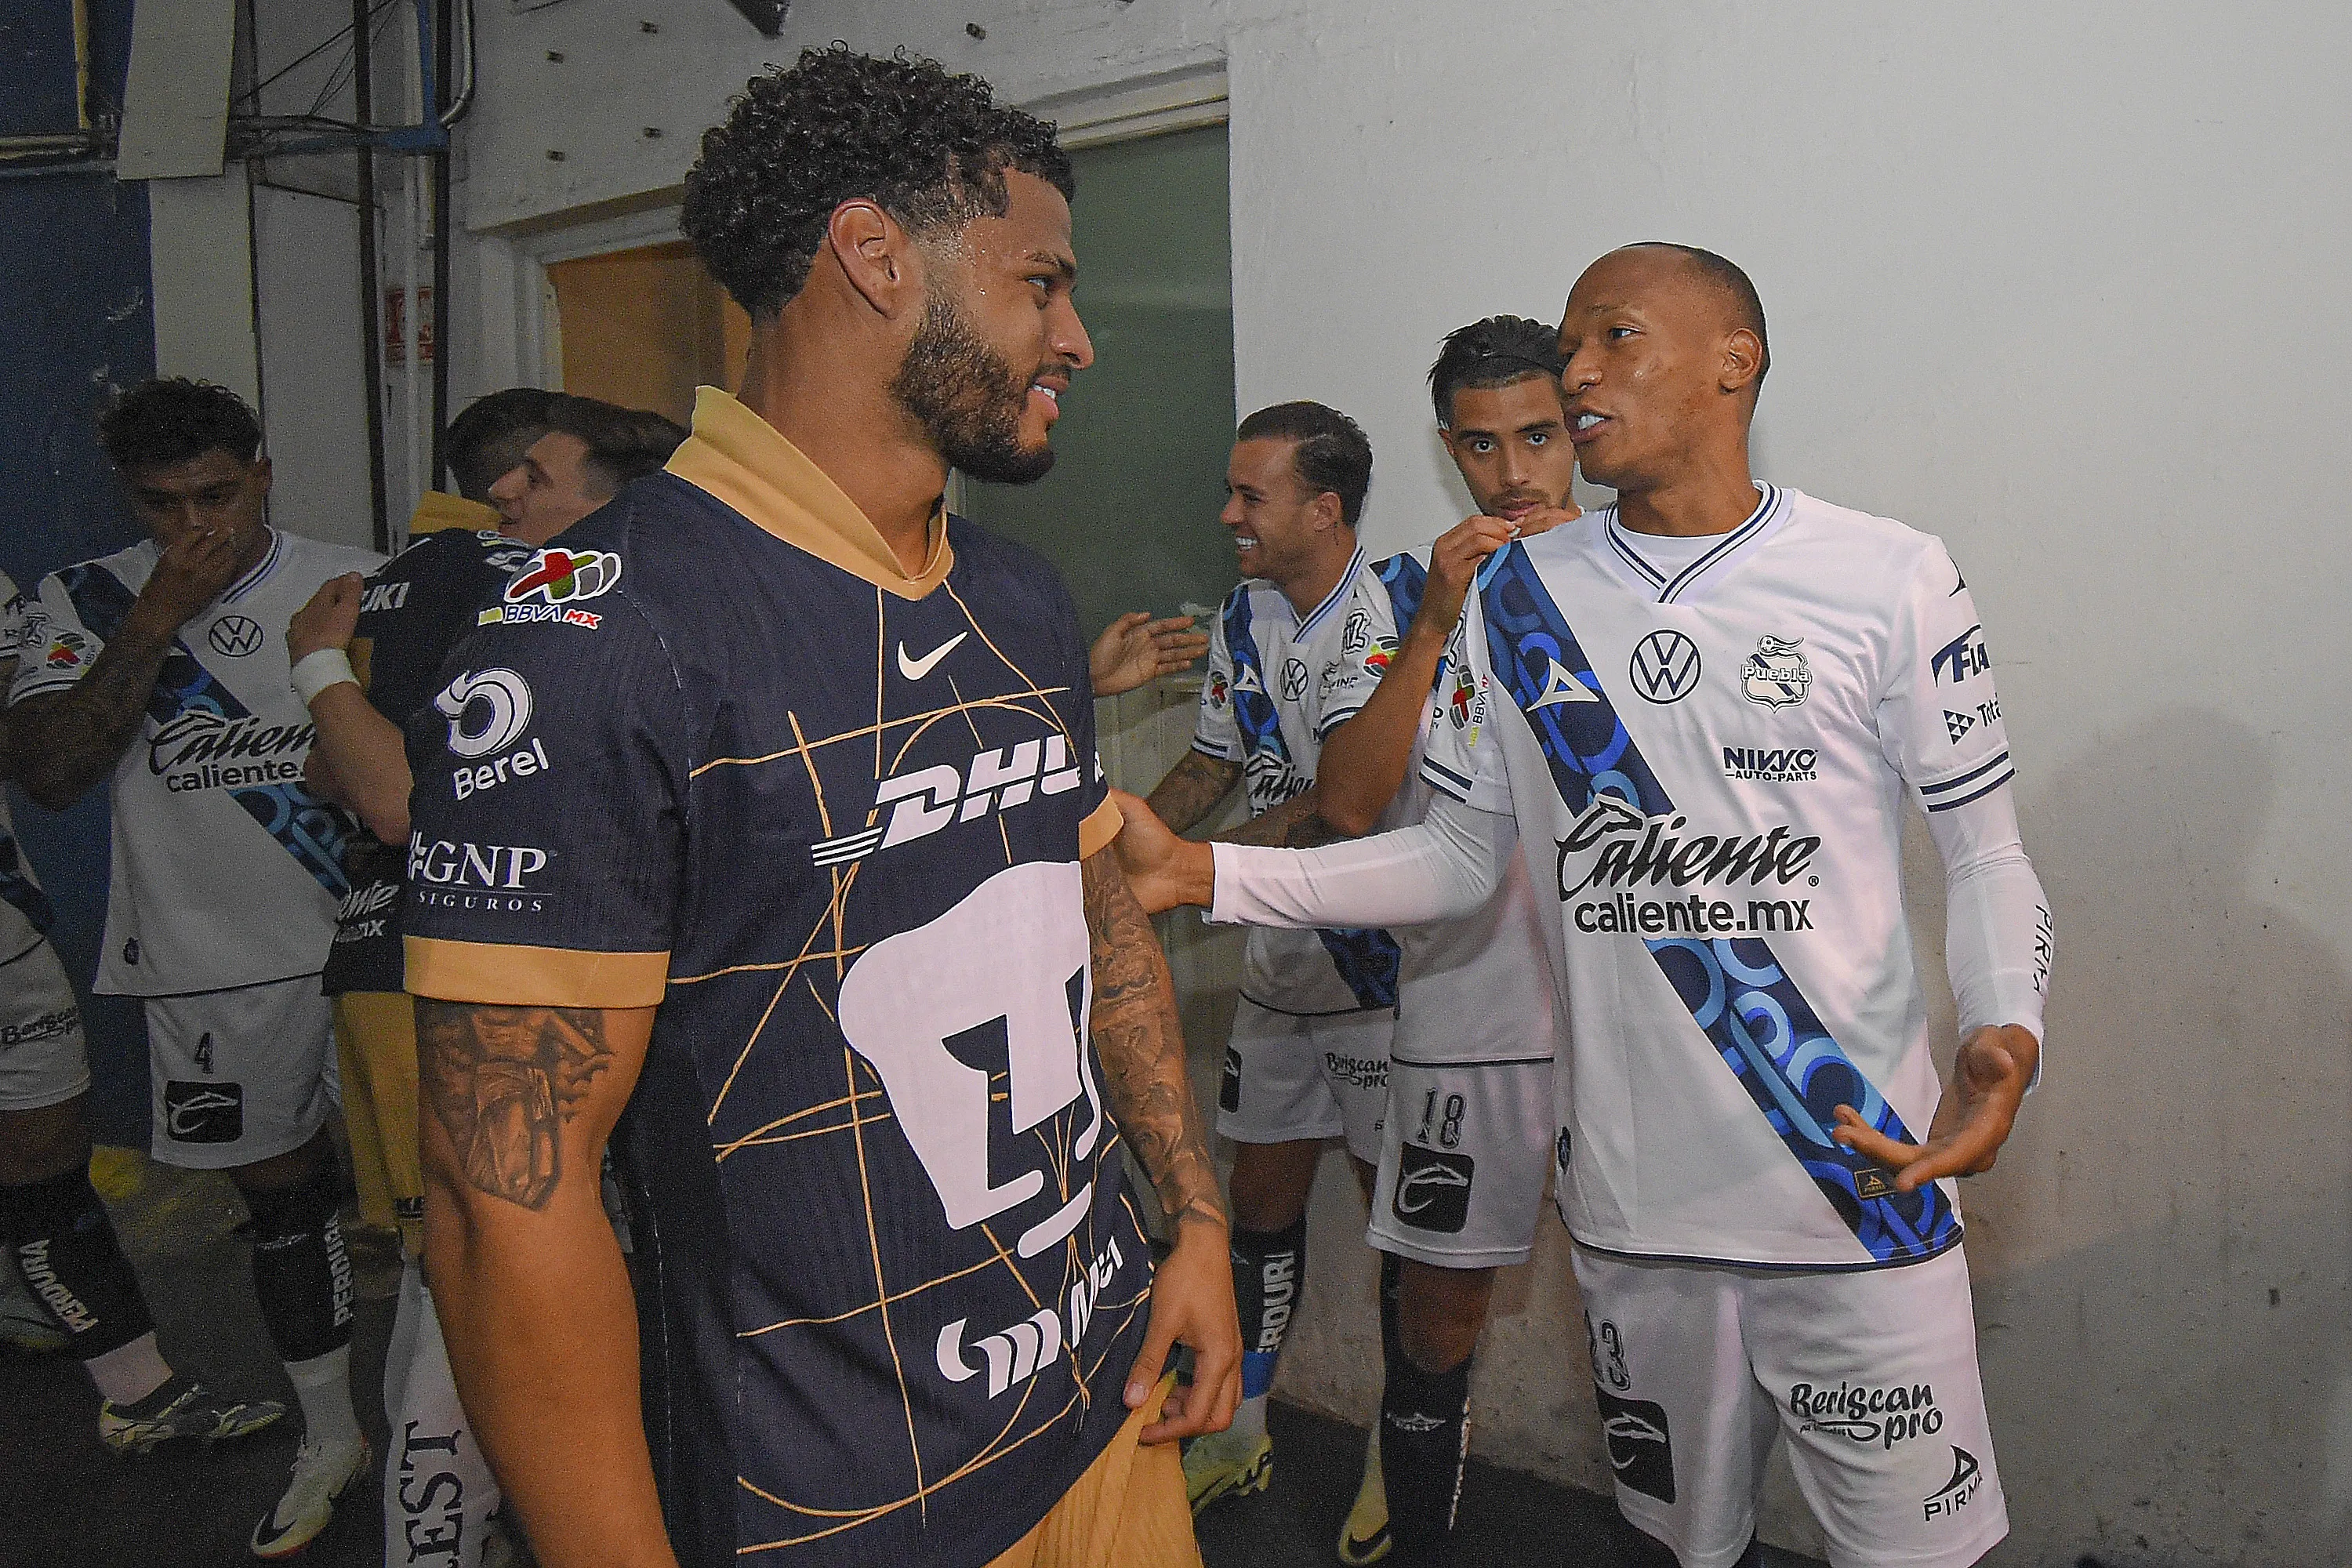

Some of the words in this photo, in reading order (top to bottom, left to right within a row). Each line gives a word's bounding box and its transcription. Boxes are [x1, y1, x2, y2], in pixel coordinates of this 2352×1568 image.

[503, 604, 561, 625] BBVA
[563, 608, 602, 630] MX
[1744, 665, 1811, 683] Puebla
[1472, 689, 1489, 724] BBVA
[149, 716, 317, 775] Calien
[1725, 747, 1817, 772] NIKKO
[165, 759, 307, 793] caliente.
[452, 737, 550, 801] Berel
[1734, 771, 1817, 782] AUTO-PARTS
[876, 734, 1080, 850] DHL
[422, 840, 547, 889] GNP
[1553, 800, 1821, 902] Caliente
[1574, 892, 1814, 933] caliente.mx
[194, 1032, 213, 1075] 4
[1417, 1087, 1468, 1149] 18
[1257, 1250, 1294, 1353] RDUR
[1790, 1381, 1933, 1421] Beriscan
[1883, 1407, 1944, 1450] pro
[398, 1420, 464, 1568] EST
